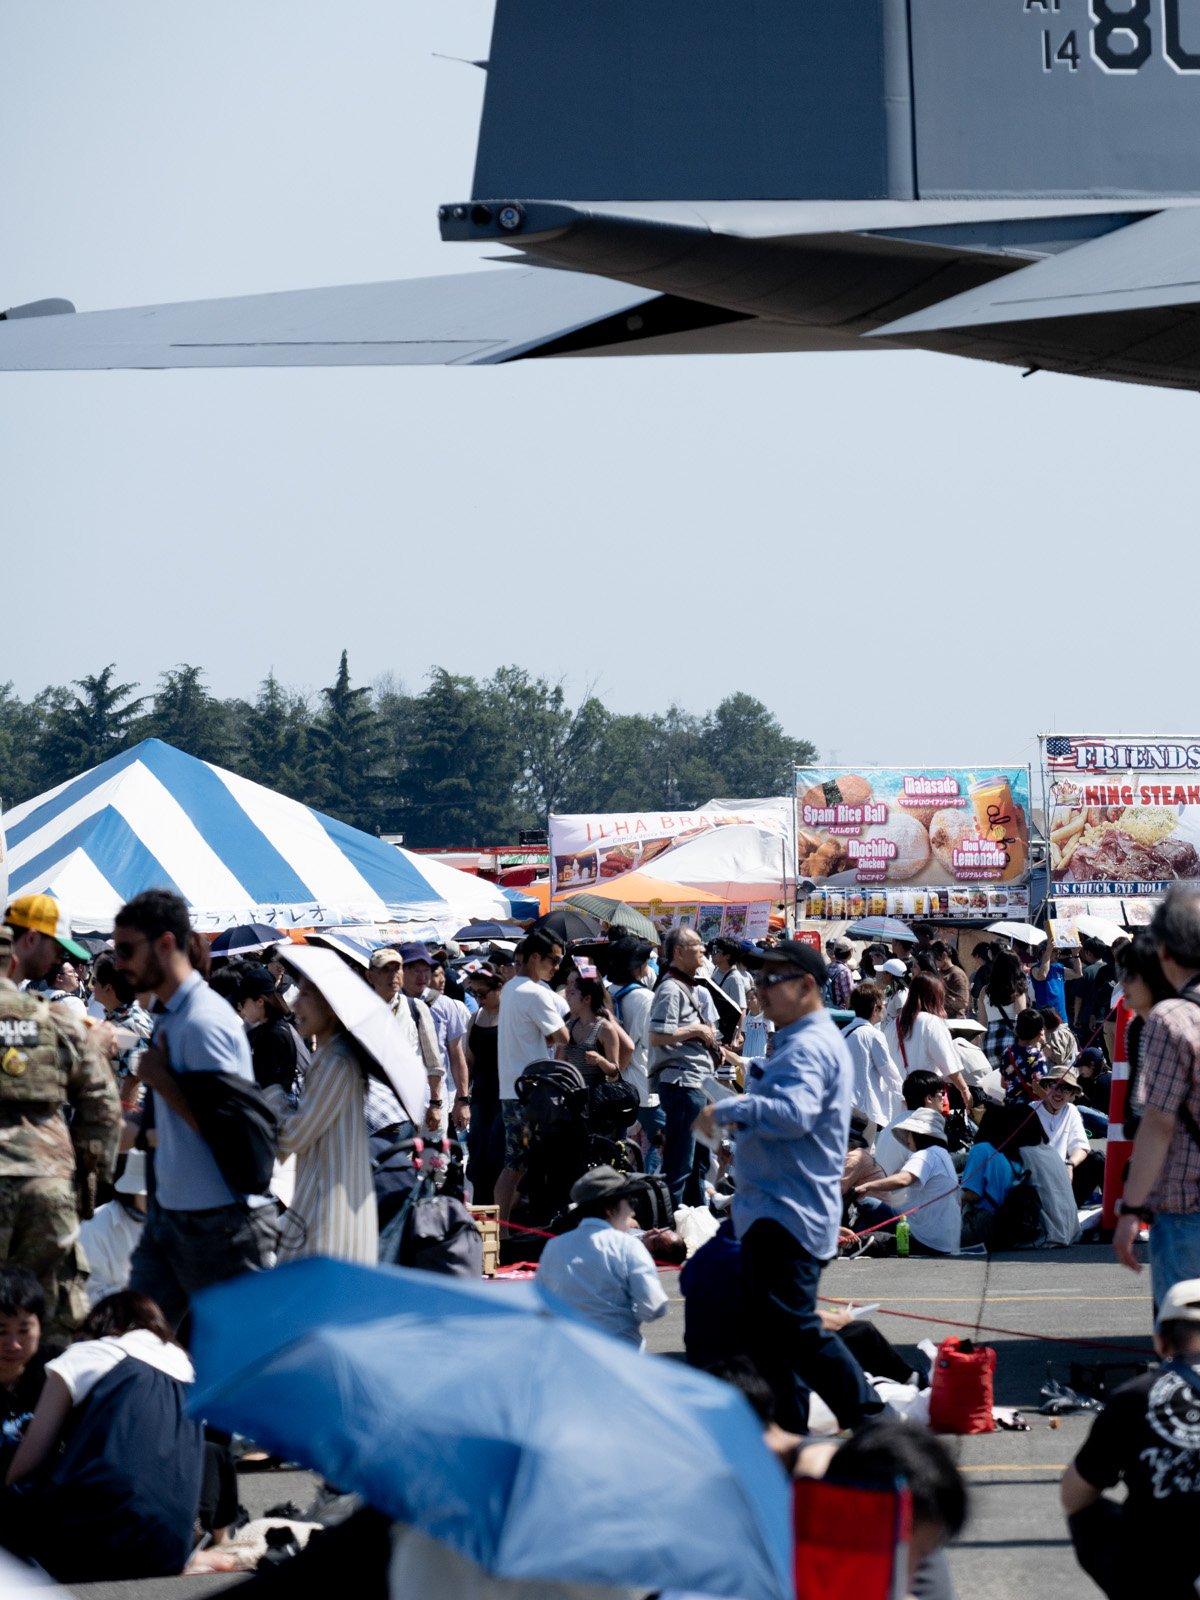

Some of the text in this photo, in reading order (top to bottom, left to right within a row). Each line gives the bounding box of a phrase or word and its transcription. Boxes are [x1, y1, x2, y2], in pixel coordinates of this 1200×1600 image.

[1041, 29, 1080, 73] 14
[904, 777, 958, 794] Malasada
[1085, 785, 1133, 806] KING
[1140, 785, 1200, 806] STEAK
[803, 804, 886, 826] Spam Rice Ball
[586, 819, 648, 841] ILHA
[848, 839, 896, 858] Mochiko
[857, 859, 886, 870] Chicken
[953, 850, 1006, 867] Lemonade
[1055, 884, 1070, 894] US
[1072, 883, 1111, 894] CHUCK
[1114, 883, 1134, 893] EYE
[1137, 882, 1164, 893] ROLL
[0, 1020, 38, 1036] OLICE
